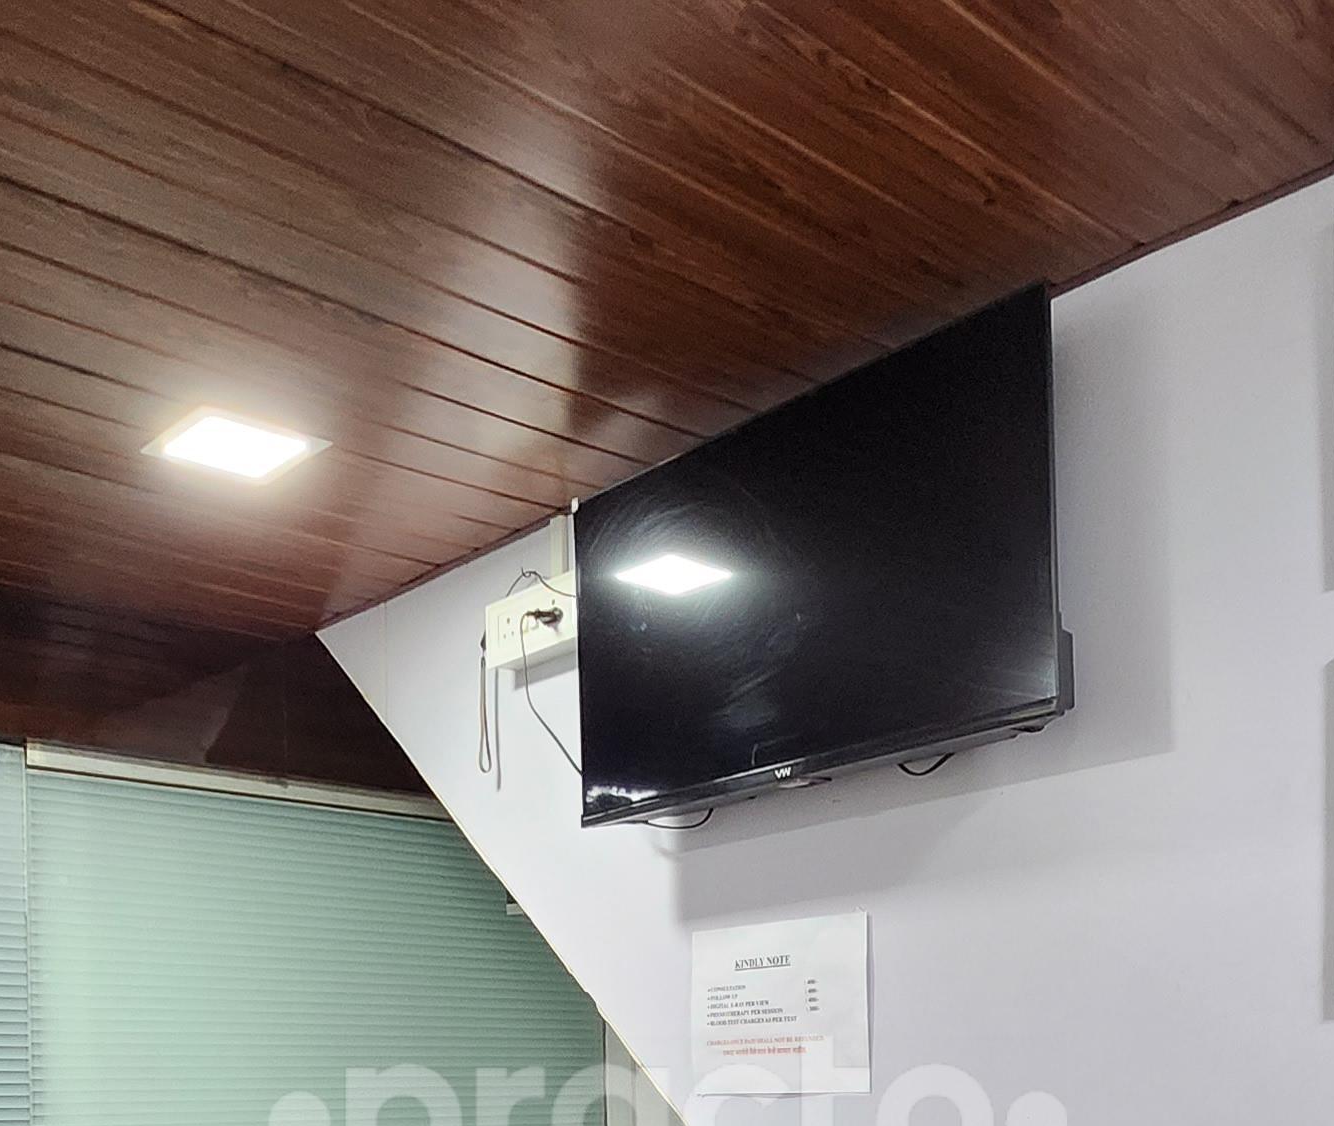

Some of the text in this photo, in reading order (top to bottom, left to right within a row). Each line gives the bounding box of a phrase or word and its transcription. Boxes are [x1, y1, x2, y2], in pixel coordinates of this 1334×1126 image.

[735, 955, 791, 970] KINDLY NOTE
[727, 1018, 739, 1026] TEST
[740, 1017, 764, 1025] CHARGES
